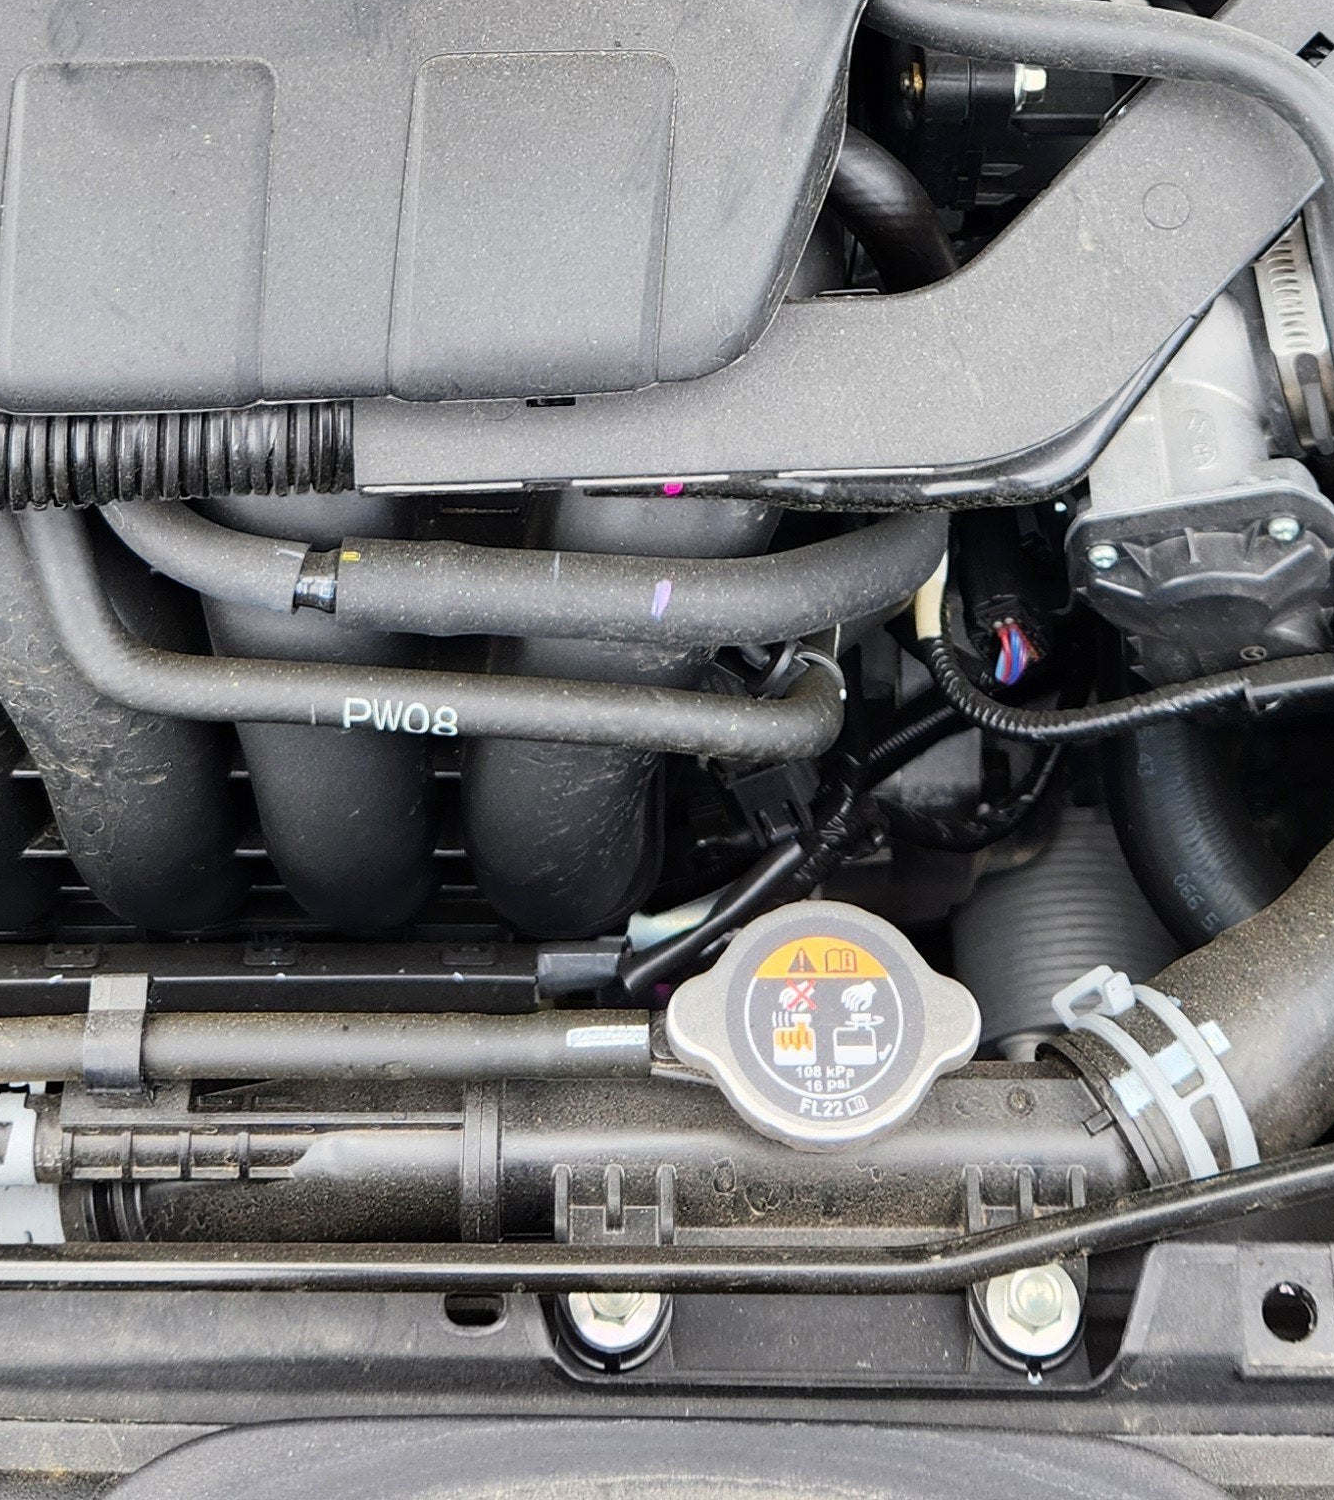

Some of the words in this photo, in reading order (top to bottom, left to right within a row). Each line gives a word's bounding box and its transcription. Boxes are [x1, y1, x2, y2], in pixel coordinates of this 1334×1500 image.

[343, 697, 458, 736] PW08
[795, 1065, 822, 1079] 108
[826, 1065, 855, 1079] kPa
[805, 1079, 824, 1093] 16
[827, 1077, 853, 1092] psi
[799, 1097, 845, 1117] FL22
